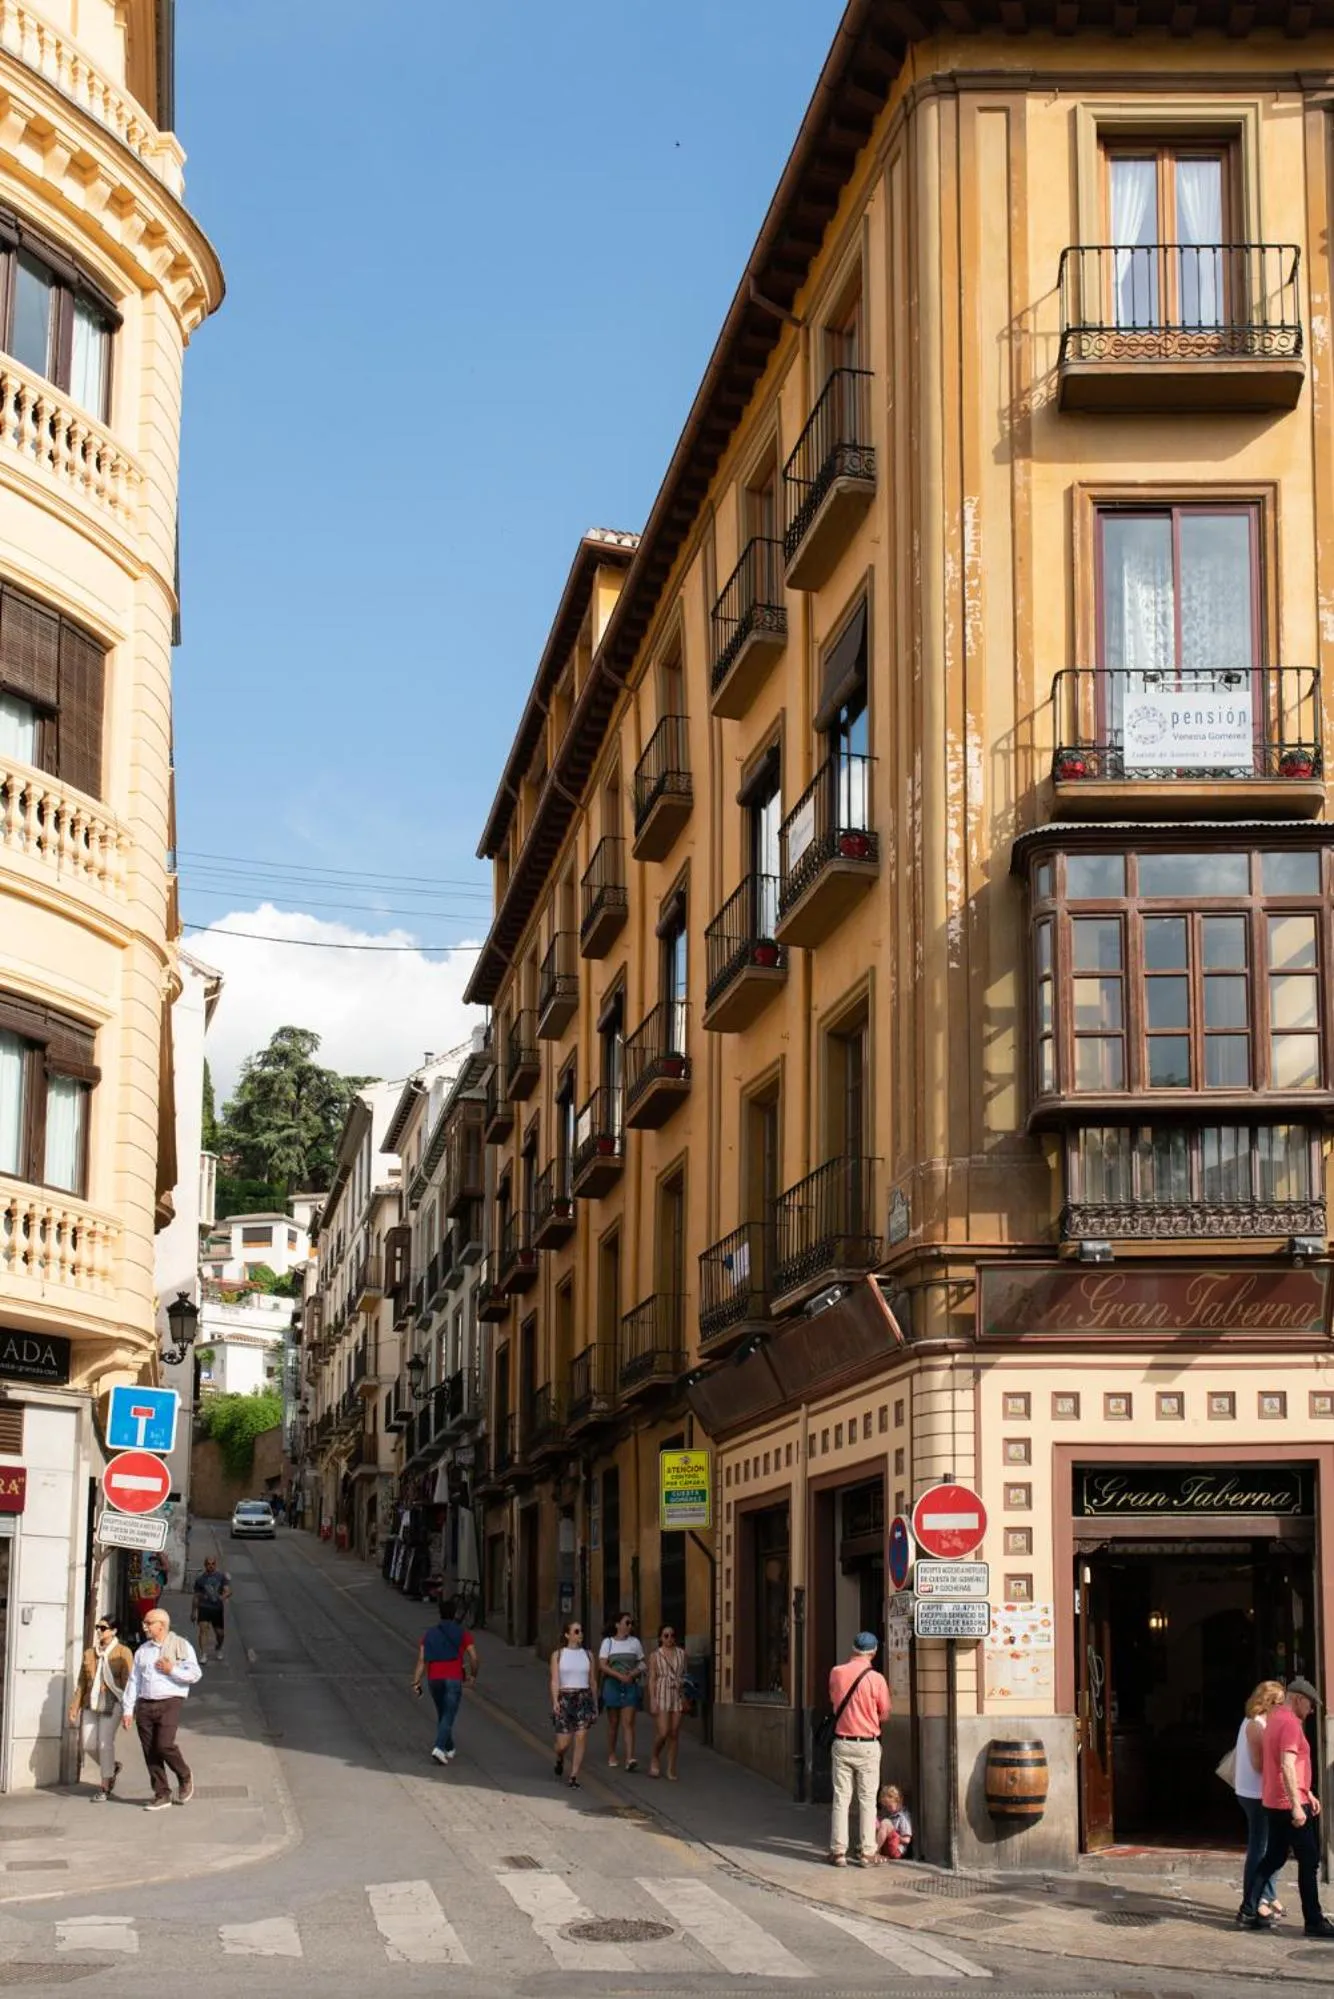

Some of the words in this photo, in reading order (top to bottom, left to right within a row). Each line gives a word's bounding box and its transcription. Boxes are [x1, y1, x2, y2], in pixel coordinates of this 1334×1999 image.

[1171, 705, 1247, 728] pensión
[1076, 1274, 1170, 1328] Gran
[1175, 1272, 1314, 1328] Taberna
[1092, 1476, 1168, 1507] Gran
[1173, 1475, 1293, 1507] Taberna
